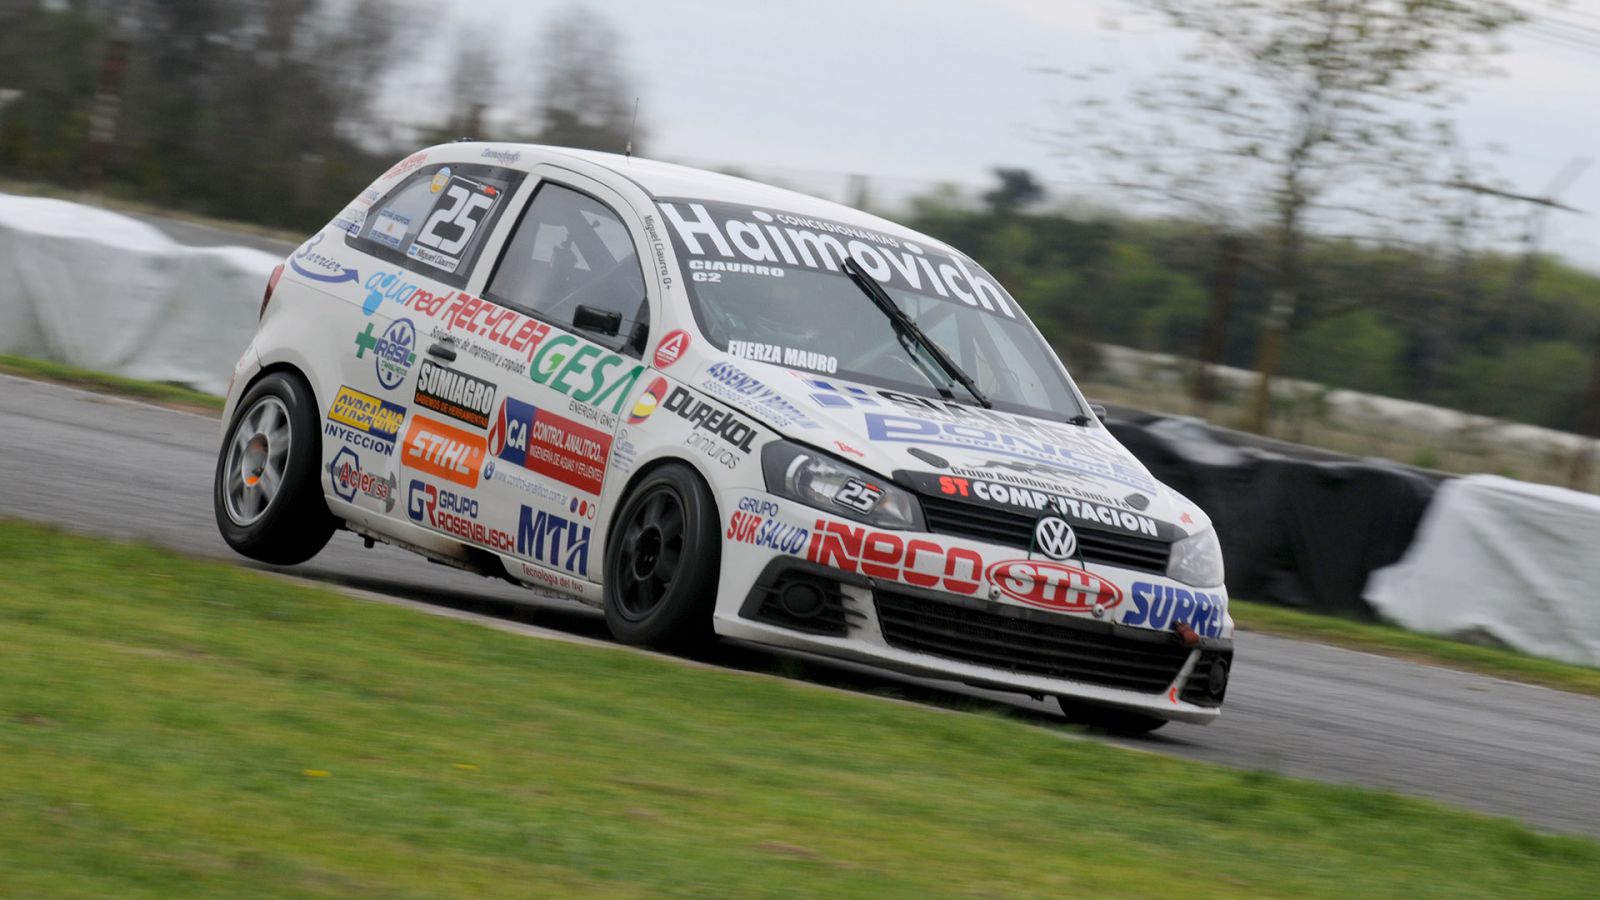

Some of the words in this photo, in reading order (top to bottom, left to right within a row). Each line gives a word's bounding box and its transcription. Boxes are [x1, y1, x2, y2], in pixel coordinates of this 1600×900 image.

[415, 184, 494, 255] 25
[775, 213, 900, 247] CONCESIONARIAS
[417, 247, 435, 263] Miguel
[644, 215, 661, 242] Miguel
[654, 243, 669, 276] Ciaurro
[658, 203, 1016, 319] Haimovich
[688, 259, 785, 277] CIAURRO
[692, 272, 721, 282] C2
[441, 292, 551, 363] RECYCLER
[728, 340, 781, 363] FUERZA
[784, 347, 837, 374] MAURO
[418, 362, 495, 414] SUMIAGRO
[507, 418, 527, 452] CA
[533, 421, 564, 448] CONTROL
[663, 386, 758, 454] DUREKOL
[324, 423, 395, 456] INYECCION
[409, 430, 471, 475] STIHL
[683, 431, 740, 470] pinturas
[340, 462, 375, 493] Acier
[951, 466, 994, 480] Grupo
[439, 490, 478, 518] GRUPO
[738, 495, 779, 517] GRUPO
[836, 482, 880, 511] 25
[941, 475, 969, 497] ST
[972, 481, 1159, 537] COMPUTACION
[437, 512, 515, 553] ROSENBUSCH
[517, 504, 591, 577] MTH
[1004, 564, 1100, 606] STH
